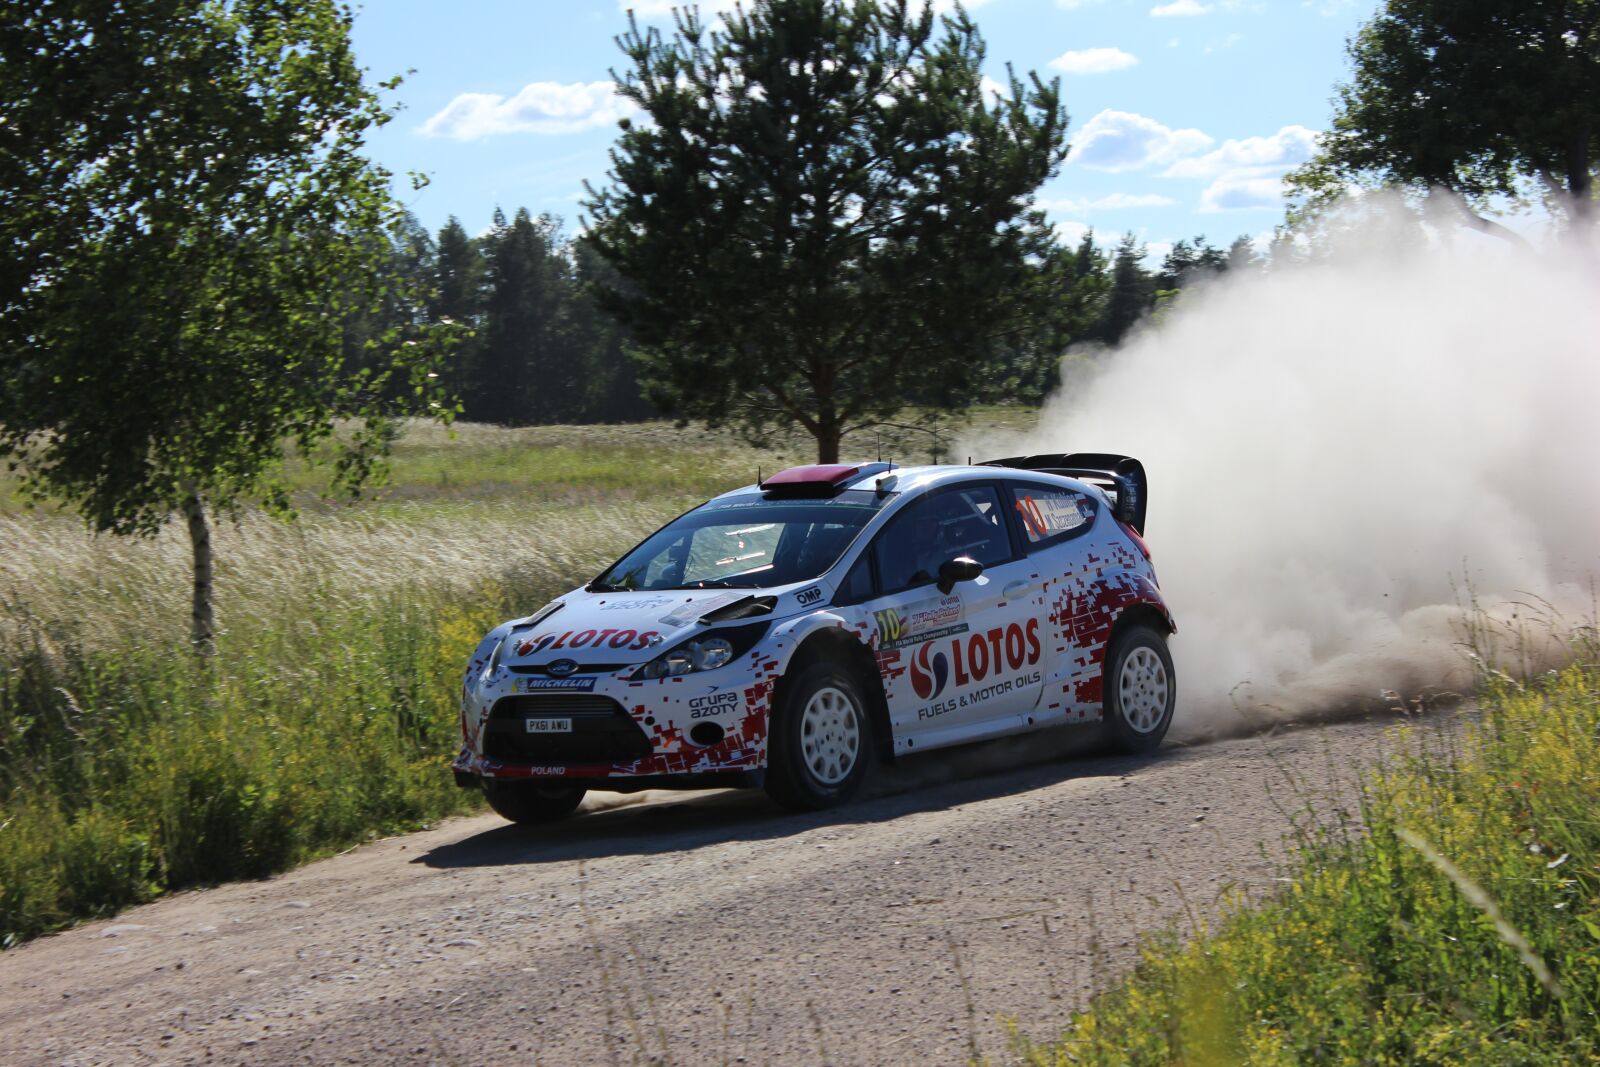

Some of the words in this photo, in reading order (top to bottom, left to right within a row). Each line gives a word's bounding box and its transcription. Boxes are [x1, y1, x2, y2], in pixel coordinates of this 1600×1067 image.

[1015, 496, 1047, 536] 10
[797, 589, 821, 604] OMP
[877, 608, 900, 642] 10
[550, 629, 658, 650] LOTOS
[952, 618, 1041, 687] LOTOS
[529, 679, 594, 688] MICHELIN
[918, 700, 957, 720] FUELS
[960, 696, 968, 707] &
[970, 681, 1013, 704] MOTOR
[1016, 671, 1041, 688] OILS
[531, 766, 565, 775] POLAND
